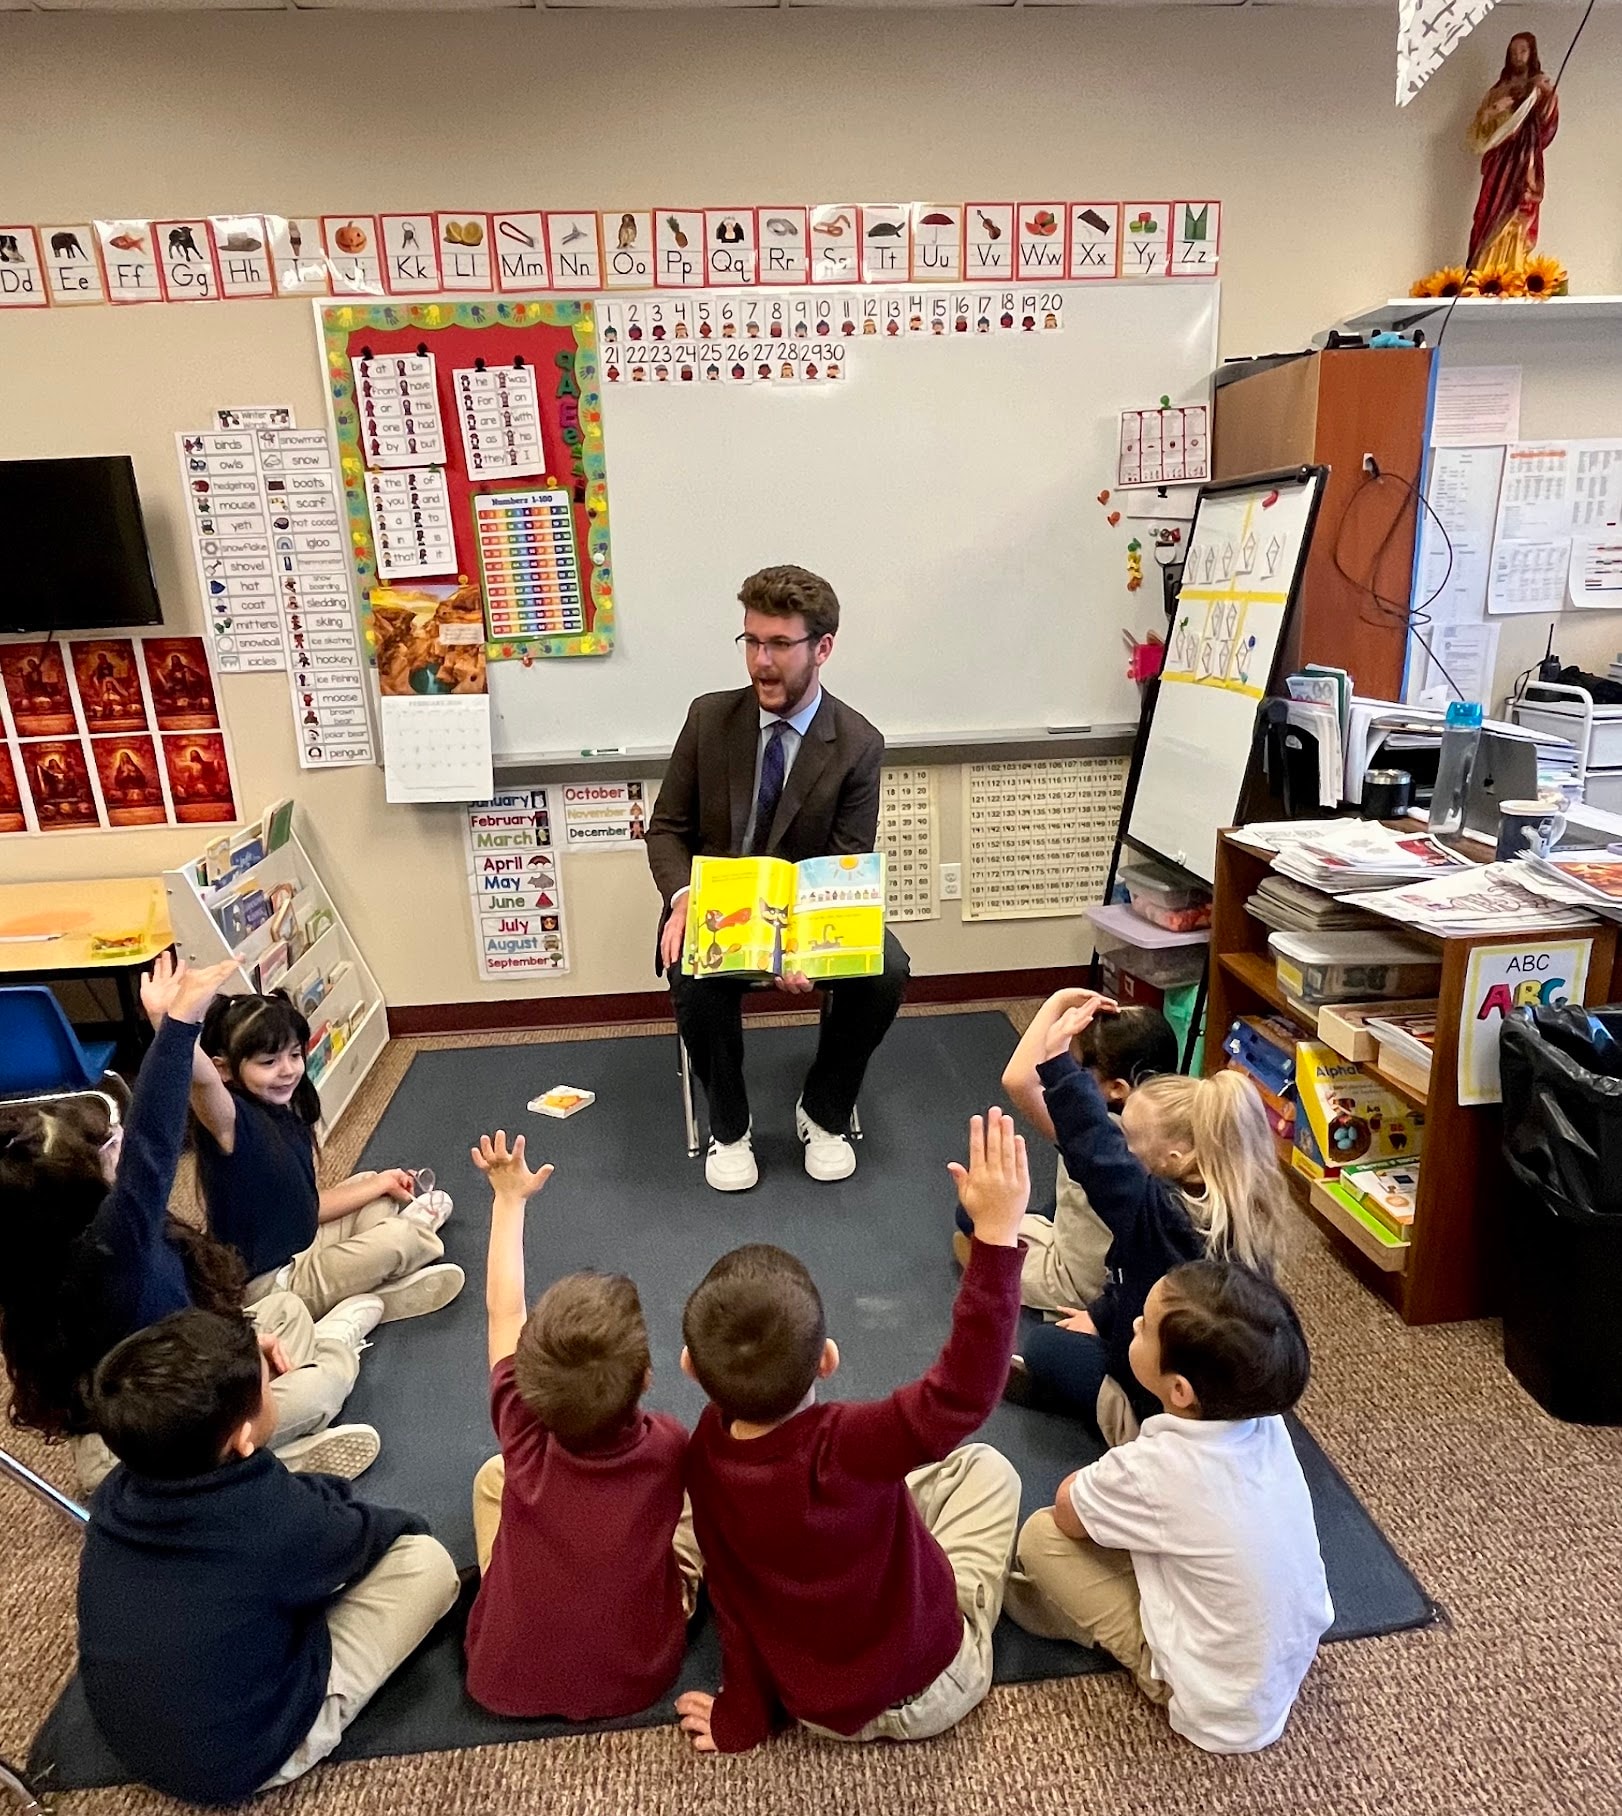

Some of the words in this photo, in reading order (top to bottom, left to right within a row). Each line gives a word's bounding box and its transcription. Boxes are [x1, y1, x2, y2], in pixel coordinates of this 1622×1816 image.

[0, 269, 33, 292] Dd
[59, 267, 89, 290] Ee
[117, 264, 144, 288] Ff
[171, 263, 209, 296] Gg
[229, 259, 261, 283] Hh
[396, 255, 428, 279] Kk
[454, 253, 476, 277] Ll
[501, 253, 544, 277] Mm
[560, 252, 590, 276] Nn
[613, 251, 646, 275] Oo
[666, 250, 693, 284] Pp
[711, 249, 751, 283] Qq
[769, 247, 795, 271] Rr
[874, 246, 897, 269] Tt
[923, 244, 949, 268] Uu
[977, 243, 1001, 267] Vv
[1020, 243, 1062, 266] Ww
[1079, 242, 1107, 265] Xx
[1132, 241, 1157, 274] Yy
[1181, 240, 1207, 263] Zz
[607, 305, 612, 322] 1
[628, 304, 639, 322] 2
[652, 304, 663, 322] 3
[675, 302, 685, 320] 4
[699, 302, 710, 320] 5
[722, 302, 733, 320] 6
[747, 302, 757, 320] 7
[771, 302, 782, 320] 8
[795, 301, 806, 319] 9
[816, 300, 830, 318] 10
[843, 300, 849, 318] 11
[864, 299, 877, 317] 12
[887, 300, 900, 318] 13
[909, 295, 922, 313] 14
[932, 299, 946, 316] 15
[955, 296, 969, 313] 16
[978, 296, 992, 314] 17
[1001, 293, 1014, 310] 18
[1022, 296, 1036, 313] 19
[1040, 293, 1063, 311] 20
[605, 346, 619, 363] 21
[626, 346, 648, 364] 22
[650, 345, 672, 363] 23
[675, 345, 697, 362] 24
[700, 344, 722, 361] 25
[727, 344, 749, 361] 26
[753, 343, 774, 361] 27
[777, 342, 798, 360] 28
[801, 344, 821, 361] 29
[823, 343, 845, 361] 30
[375, 364, 386, 374] at
[411, 362, 423, 371] be
[475, 377, 488, 386] he
[507, 376, 527, 384] was
[409, 381, 430, 390] have
[514, 393, 527, 402] on
[380, 404, 392, 413] or
[416, 401, 432, 411] this
[480, 417, 497, 426] are
[512, 411, 533, 422] with
[382, 424, 400, 432] one
[418, 420, 435, 429] had
[214, 440, 242, 450] birds
[280, 436, 325, 444] snowman
[420, 439, 436, 449] but
[485, 436, 498, 444] as
[386, 442, 399, 453] by
[292, 456, 319, 465] snow
[484, 454, 505, 463] they
[219, 459, 244, 469] owls
[292, 477, 325, 488] boots
[384, 478, 402, 488] the
[423, 475, 435, 485] of
[213, 480, 256, 491] hedgehog
[296, 497, 327, 508] scarf
[387, 498, 405, 508] you
[422, 494, 440, 504] and
[491, 497, 529, 506] Numbers
[532, 495, 553, 504] 1-100
[219, 501, 256, 510] mouse
[292, 519, 308, 527] hot
[311, 519, 338, 527] cocoa
[395, 517, 403, 525] a
[428, 513, 439, 523] to
[231, 521, 252, 532] yeti
[222, 543, 267, 552] snowflake
[306, 539, 330, 550] igloo
[393, 552, 415, 562] that
[231, 560, 265, 571] shovel
[240, 581, 260, 591] hat
[241, 600, 265, 610] coat
[307, 599, 347, 609] sledding
[236, 620, 279, 630] mittens
[239, 637, 280, 648] snowball
[315, 655, 353, 665] hockey
[322, 694, 358, 702] moose
[330, 749, 368, 759] penguin
[917, 771, 926, 779] 10
[565, 787, 625, 801] October
[917, 787, 927, 795] 20
[567, 808, 627, 819] November
[471, 815, 536, 828] February
[569, 826, 628, 839] December
[477, 831, 533, 848] March
[483, 856, 523, 873] April
[484, 875, 521, 891] May
[488, 895, 525, 910] June
[498, 918, 529, 935] July
[487, 936, 538, 953] August
[487, 957, 549, 969] September
[1505, 954, 1550, 974] ABC
